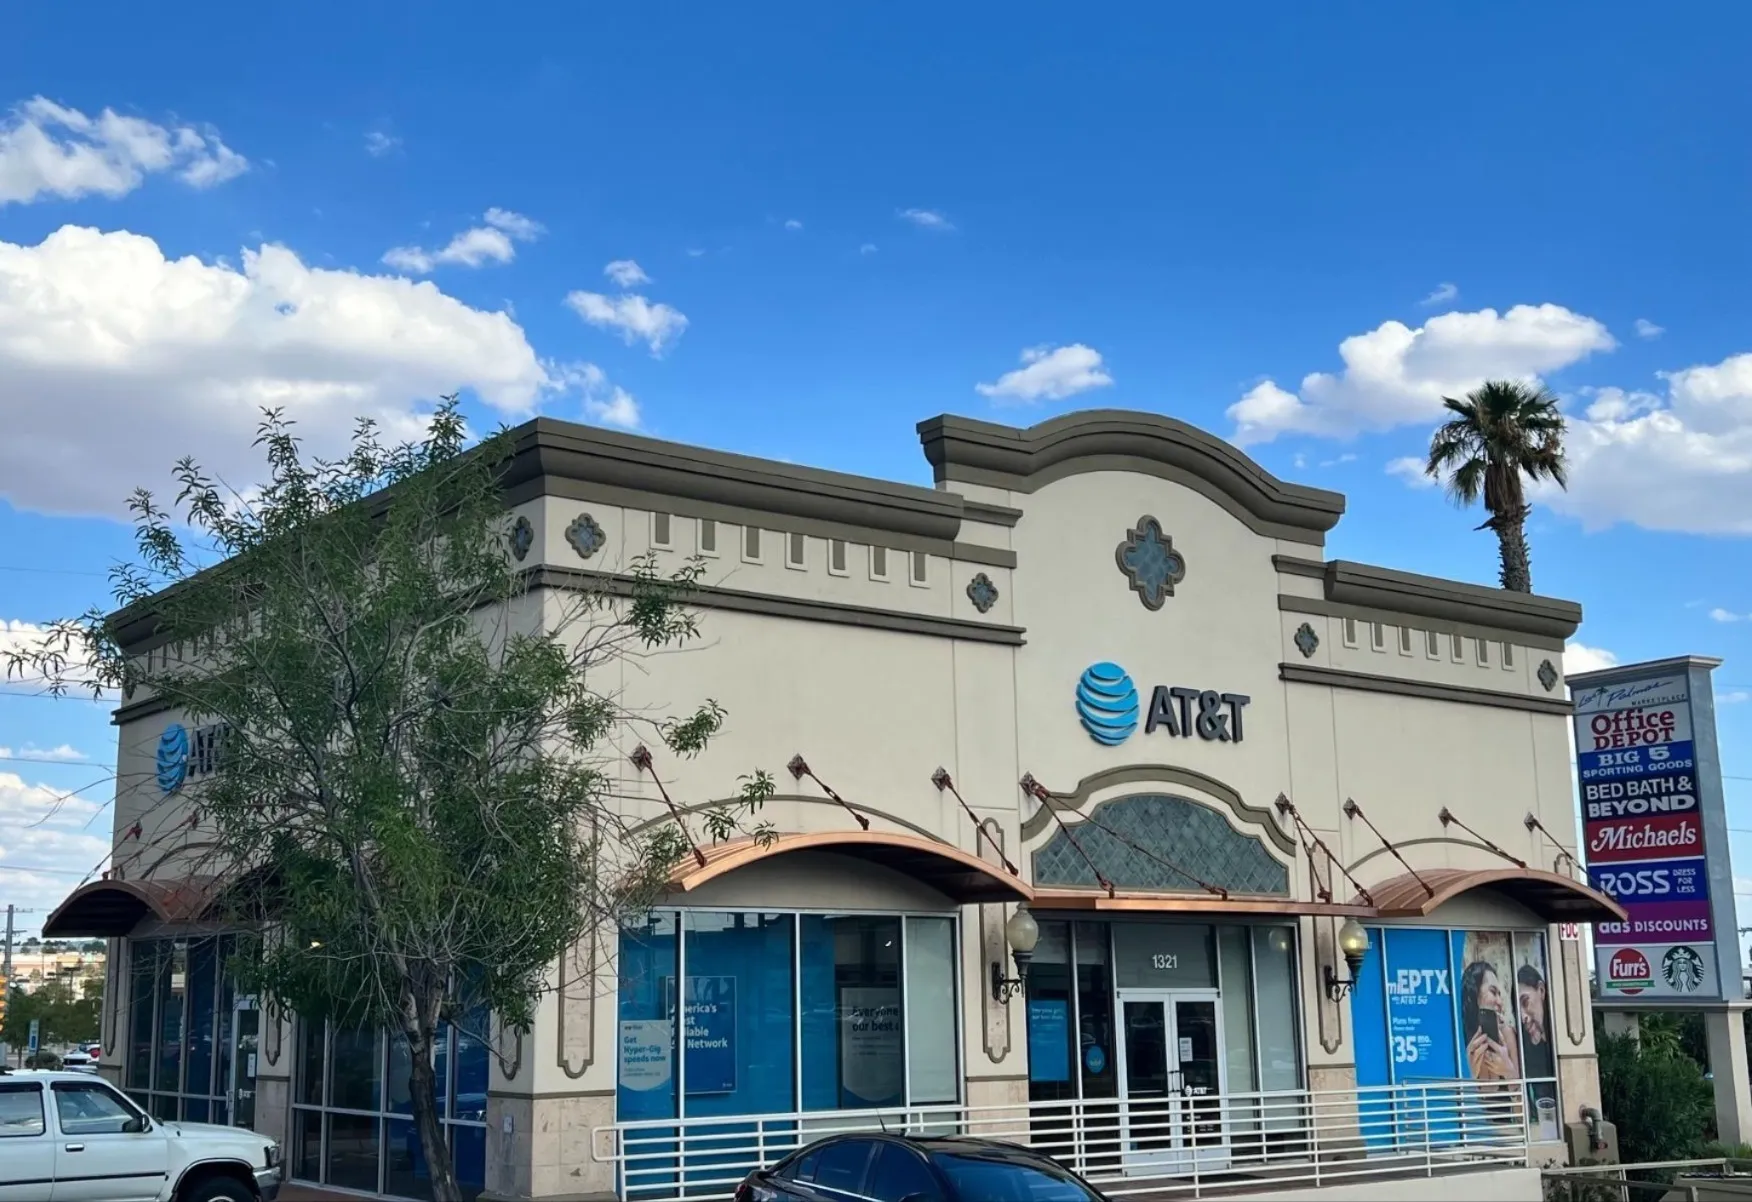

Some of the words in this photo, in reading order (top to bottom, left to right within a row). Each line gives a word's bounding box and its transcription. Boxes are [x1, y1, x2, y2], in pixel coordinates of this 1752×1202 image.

[1145, 685, 1251, 743] AT&T
[1591, 708, 1675, 735] Office
[1594, 727, 1675, 750] DEPOT
[1598, 751, 1640, 767] BIG
[1648, 746, 1670, 760] 5
[1583, 765, 1643, 778] SPORTING
[1648, 759, 1693, 771] GOODS
[1586, 783, 1623, 800] BED
[1627, 779, 1674, 796] BATH
[1677, 776, 1693, 791] &
[1588, 795, 1695, 817] BEYOND
[1591, 821, 1696, 851] Michaels
[1672, 868, 1696, 876] DRESS
[1600, 870, 1671, 895] ROSS
[1677, 885, 1696, 893] LESS
[1678, 877, 1693, 885] FOR
[1561, 922, 1579, 938] FDC
[1635, 919, 1708, 933] DISCOUNTS
[1152, 954, 1178, 969] 1321
[1613, 957, 1647, 977] Furr's
[852, 1022, 869, 1032] our
[871, 1020, 893, 1031] best
[624, 1036, 637, 1044] Get
[687, 1037, 728, 1049] Network
[624, 1045, 661, 1055] Hyper-Gig
[624, 1055, 650, 1065] speeds
